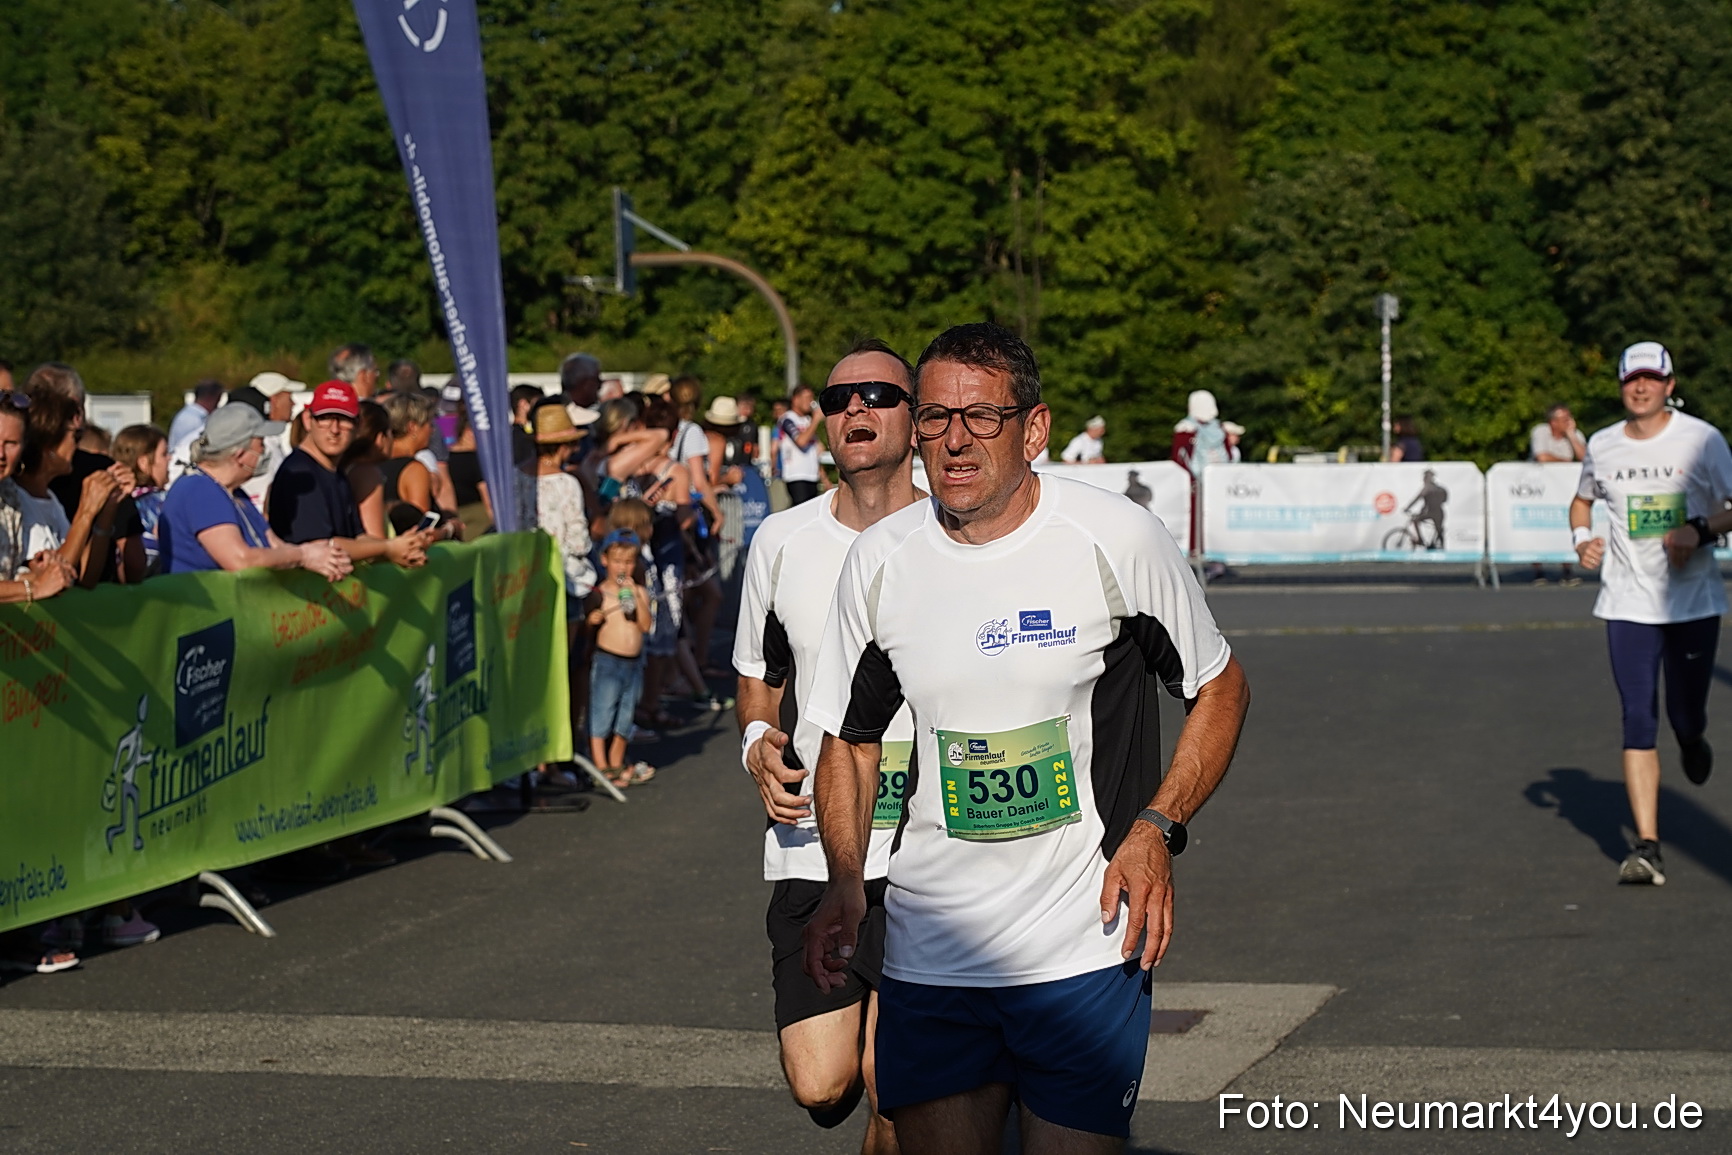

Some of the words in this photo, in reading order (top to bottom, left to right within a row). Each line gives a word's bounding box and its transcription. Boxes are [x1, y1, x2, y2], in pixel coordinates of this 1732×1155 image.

[1615, 467, 1673, 480] APTIV
[1642, 509, 1673, 524] 234
[1011, 626, 1077, 644] Firmenlauf
[1038, 637, 1076, 649] neumarkt
[149, 693, 271, 812] firmenlauf
[965, 750, 1006, 761] Firmenlauf
[979, 758, 1006, 766] neumarkt
[968, 764, 1039, 805] 530
[1053, 759, 1072, 809] 2022
[947, 780, 960, 817] RUN
[149, 794, 209, 839] neumarkt
[966, 807, 1004, 820] Bauer
[1007, 798, 1050, 818] Daniel
